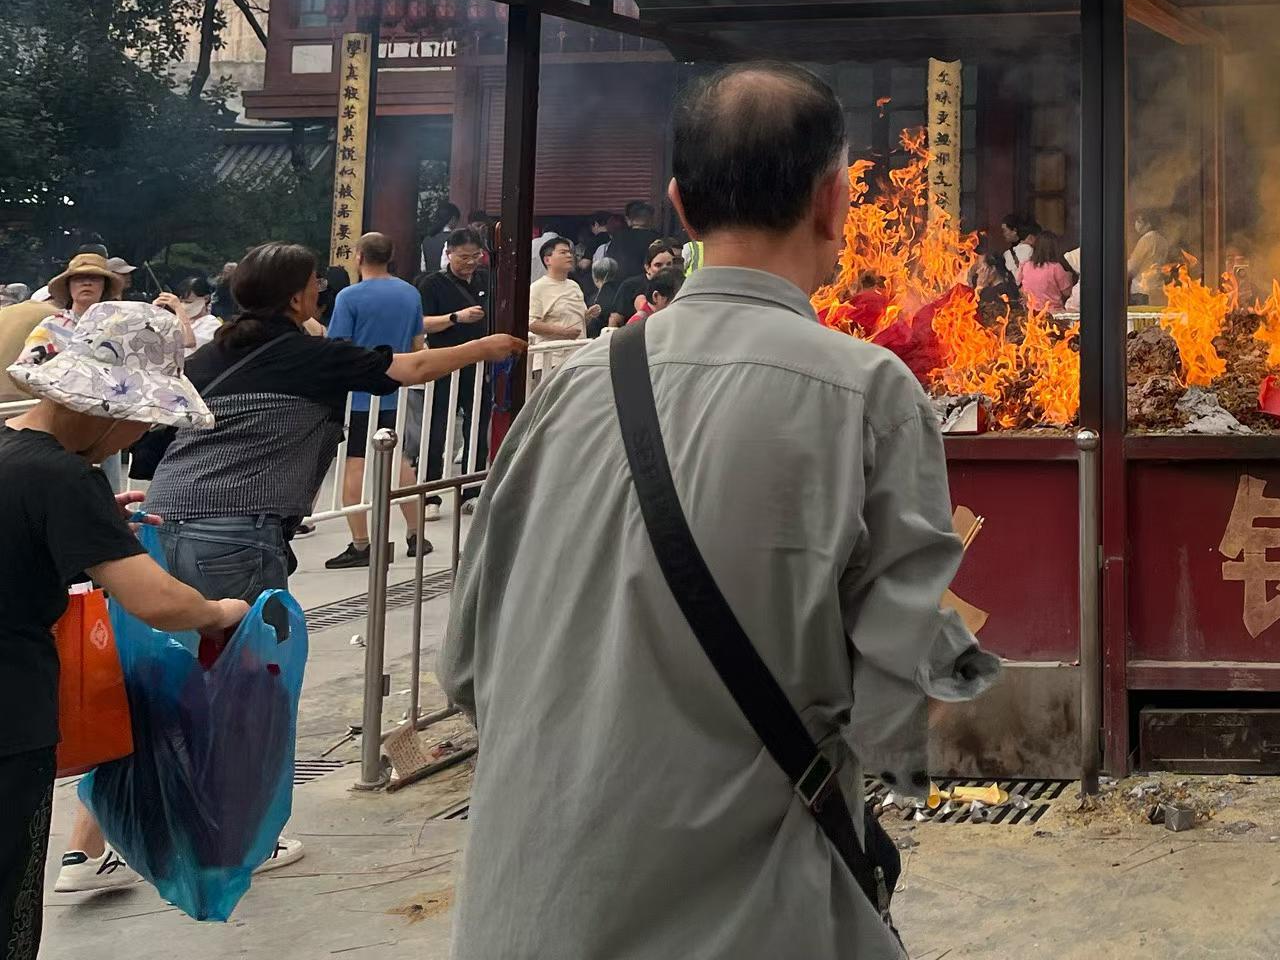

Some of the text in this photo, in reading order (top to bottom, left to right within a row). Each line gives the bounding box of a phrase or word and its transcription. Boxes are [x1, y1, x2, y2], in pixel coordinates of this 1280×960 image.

[336, 39, 361, 270] 學真般若莫說似般若要將
